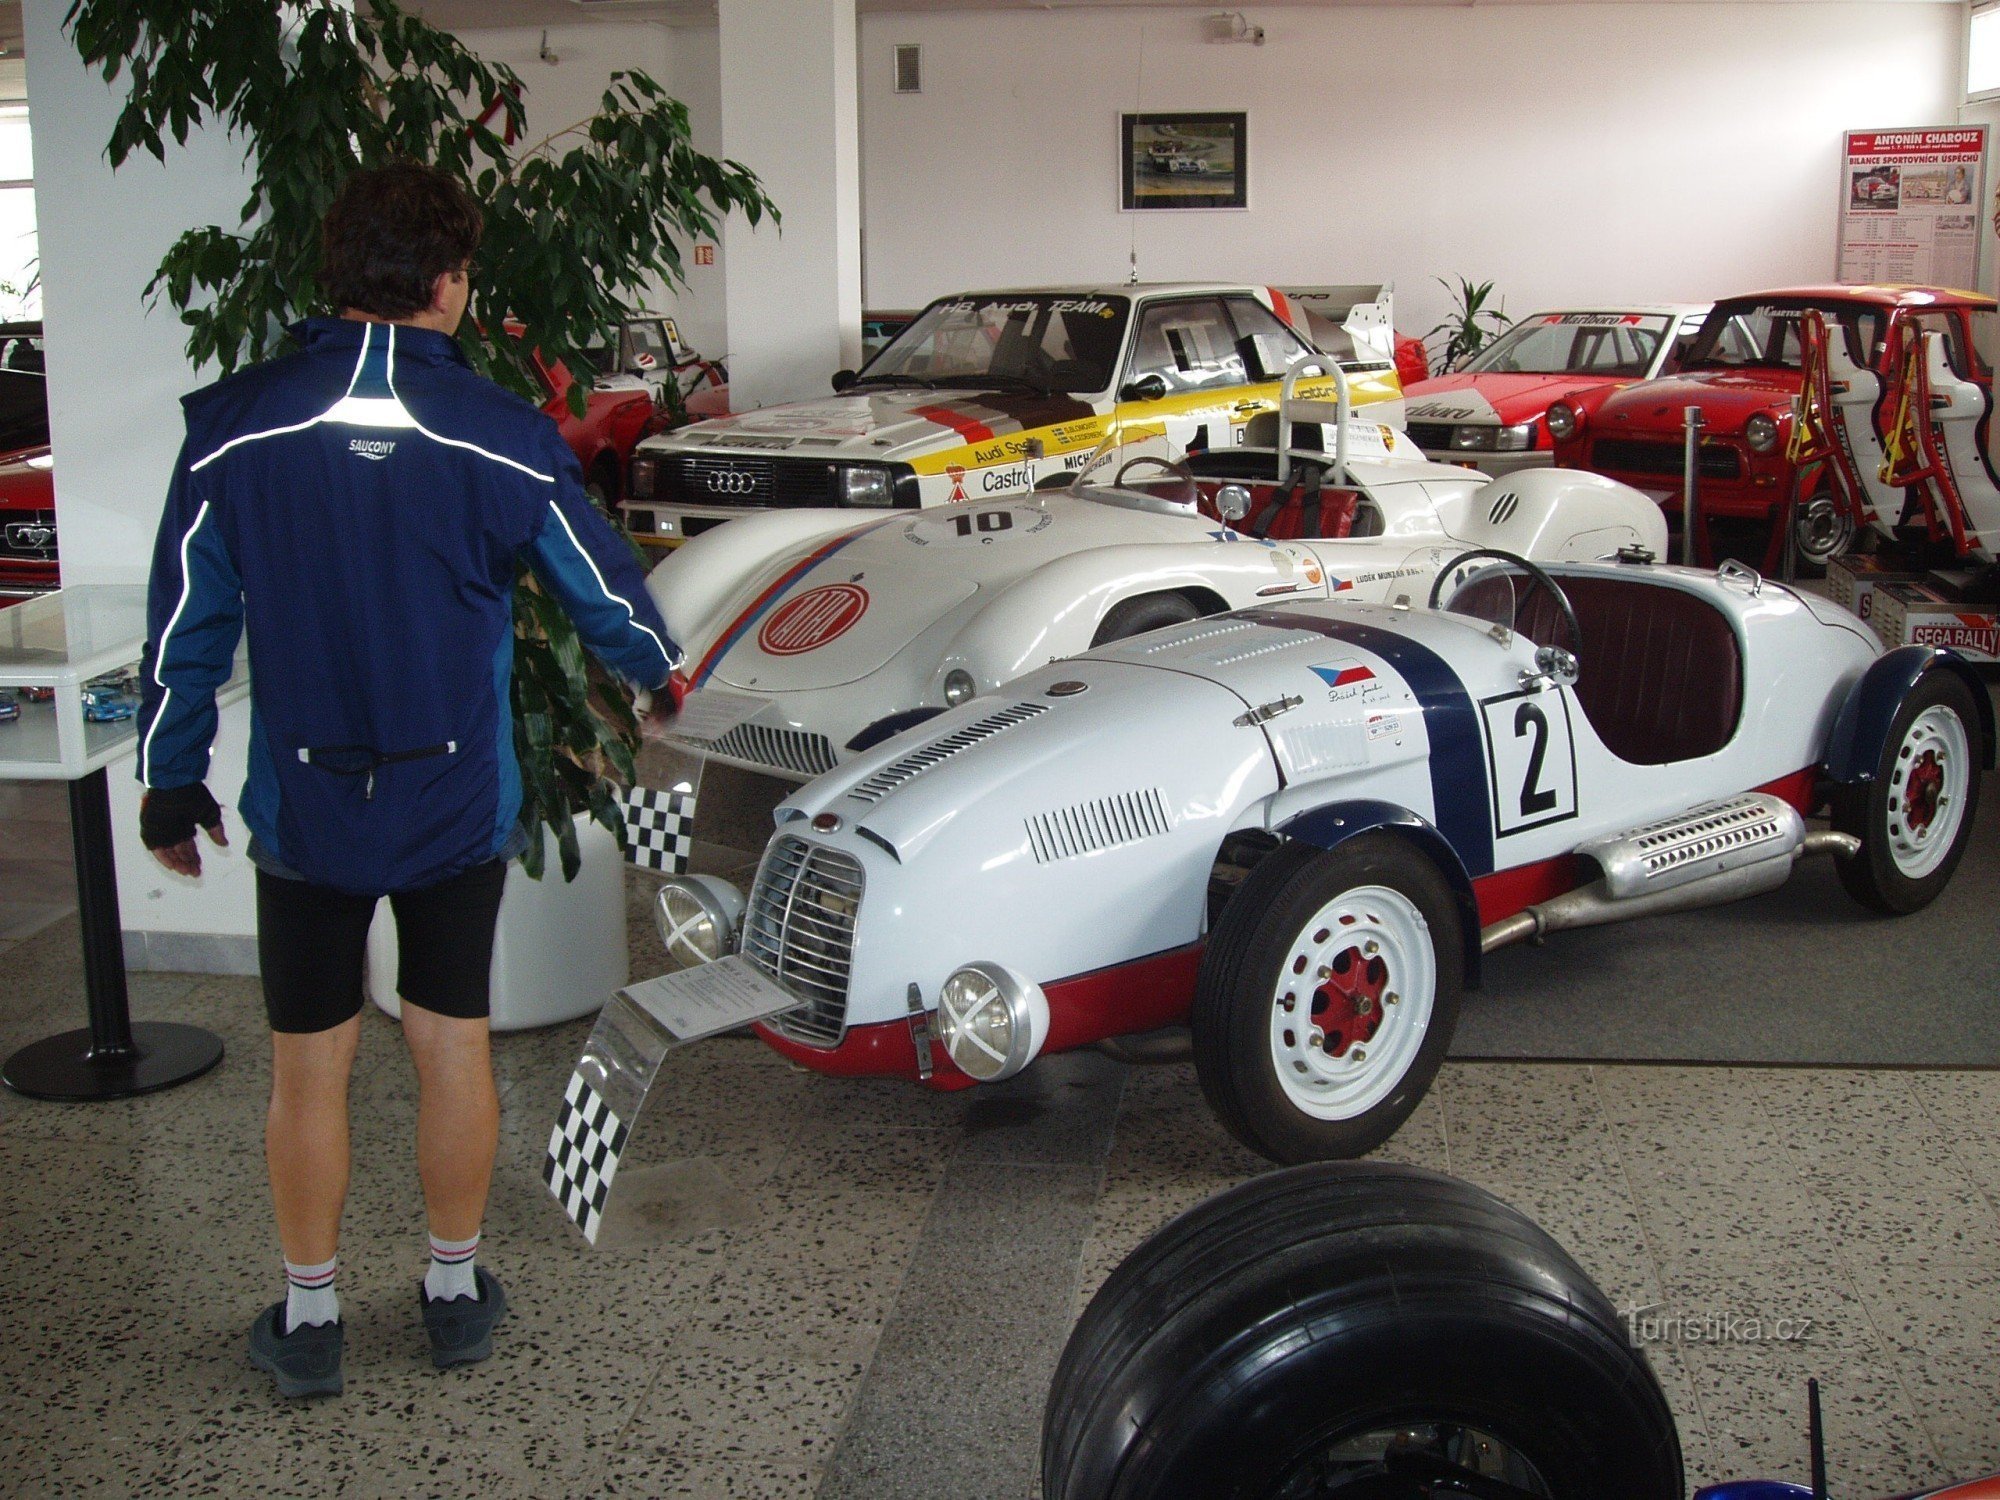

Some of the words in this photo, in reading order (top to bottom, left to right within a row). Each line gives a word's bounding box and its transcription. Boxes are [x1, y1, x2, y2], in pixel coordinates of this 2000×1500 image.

[1874, 132, 1922, 146] ANTONÍN
[1926, 131, 1978, 144] CHAROUZ
[1849, 156, 1880, 165] BILANCE
[1882, 153, 1939, 164] SPORTOVNÍCH
[1941, 152, 1979, 163] ÚSPĚCHŮ
[939, 301, 976, 315] HB
[1047, 300, 1108, 314] TEAM
[1558, 314, 1620, 326] Marlboro
[349, 439, 396, 454] SAUCONY
[975, 445, 1005, 464] Audi
[983, 464, 1035, 492] Castrol
[946, 511, 1013, 537] 10
[1915, 628, 1951, 645] SEGA
[1955, 629, 1998, 653] RALLY
[1514, 702, 1557, 817] 2
